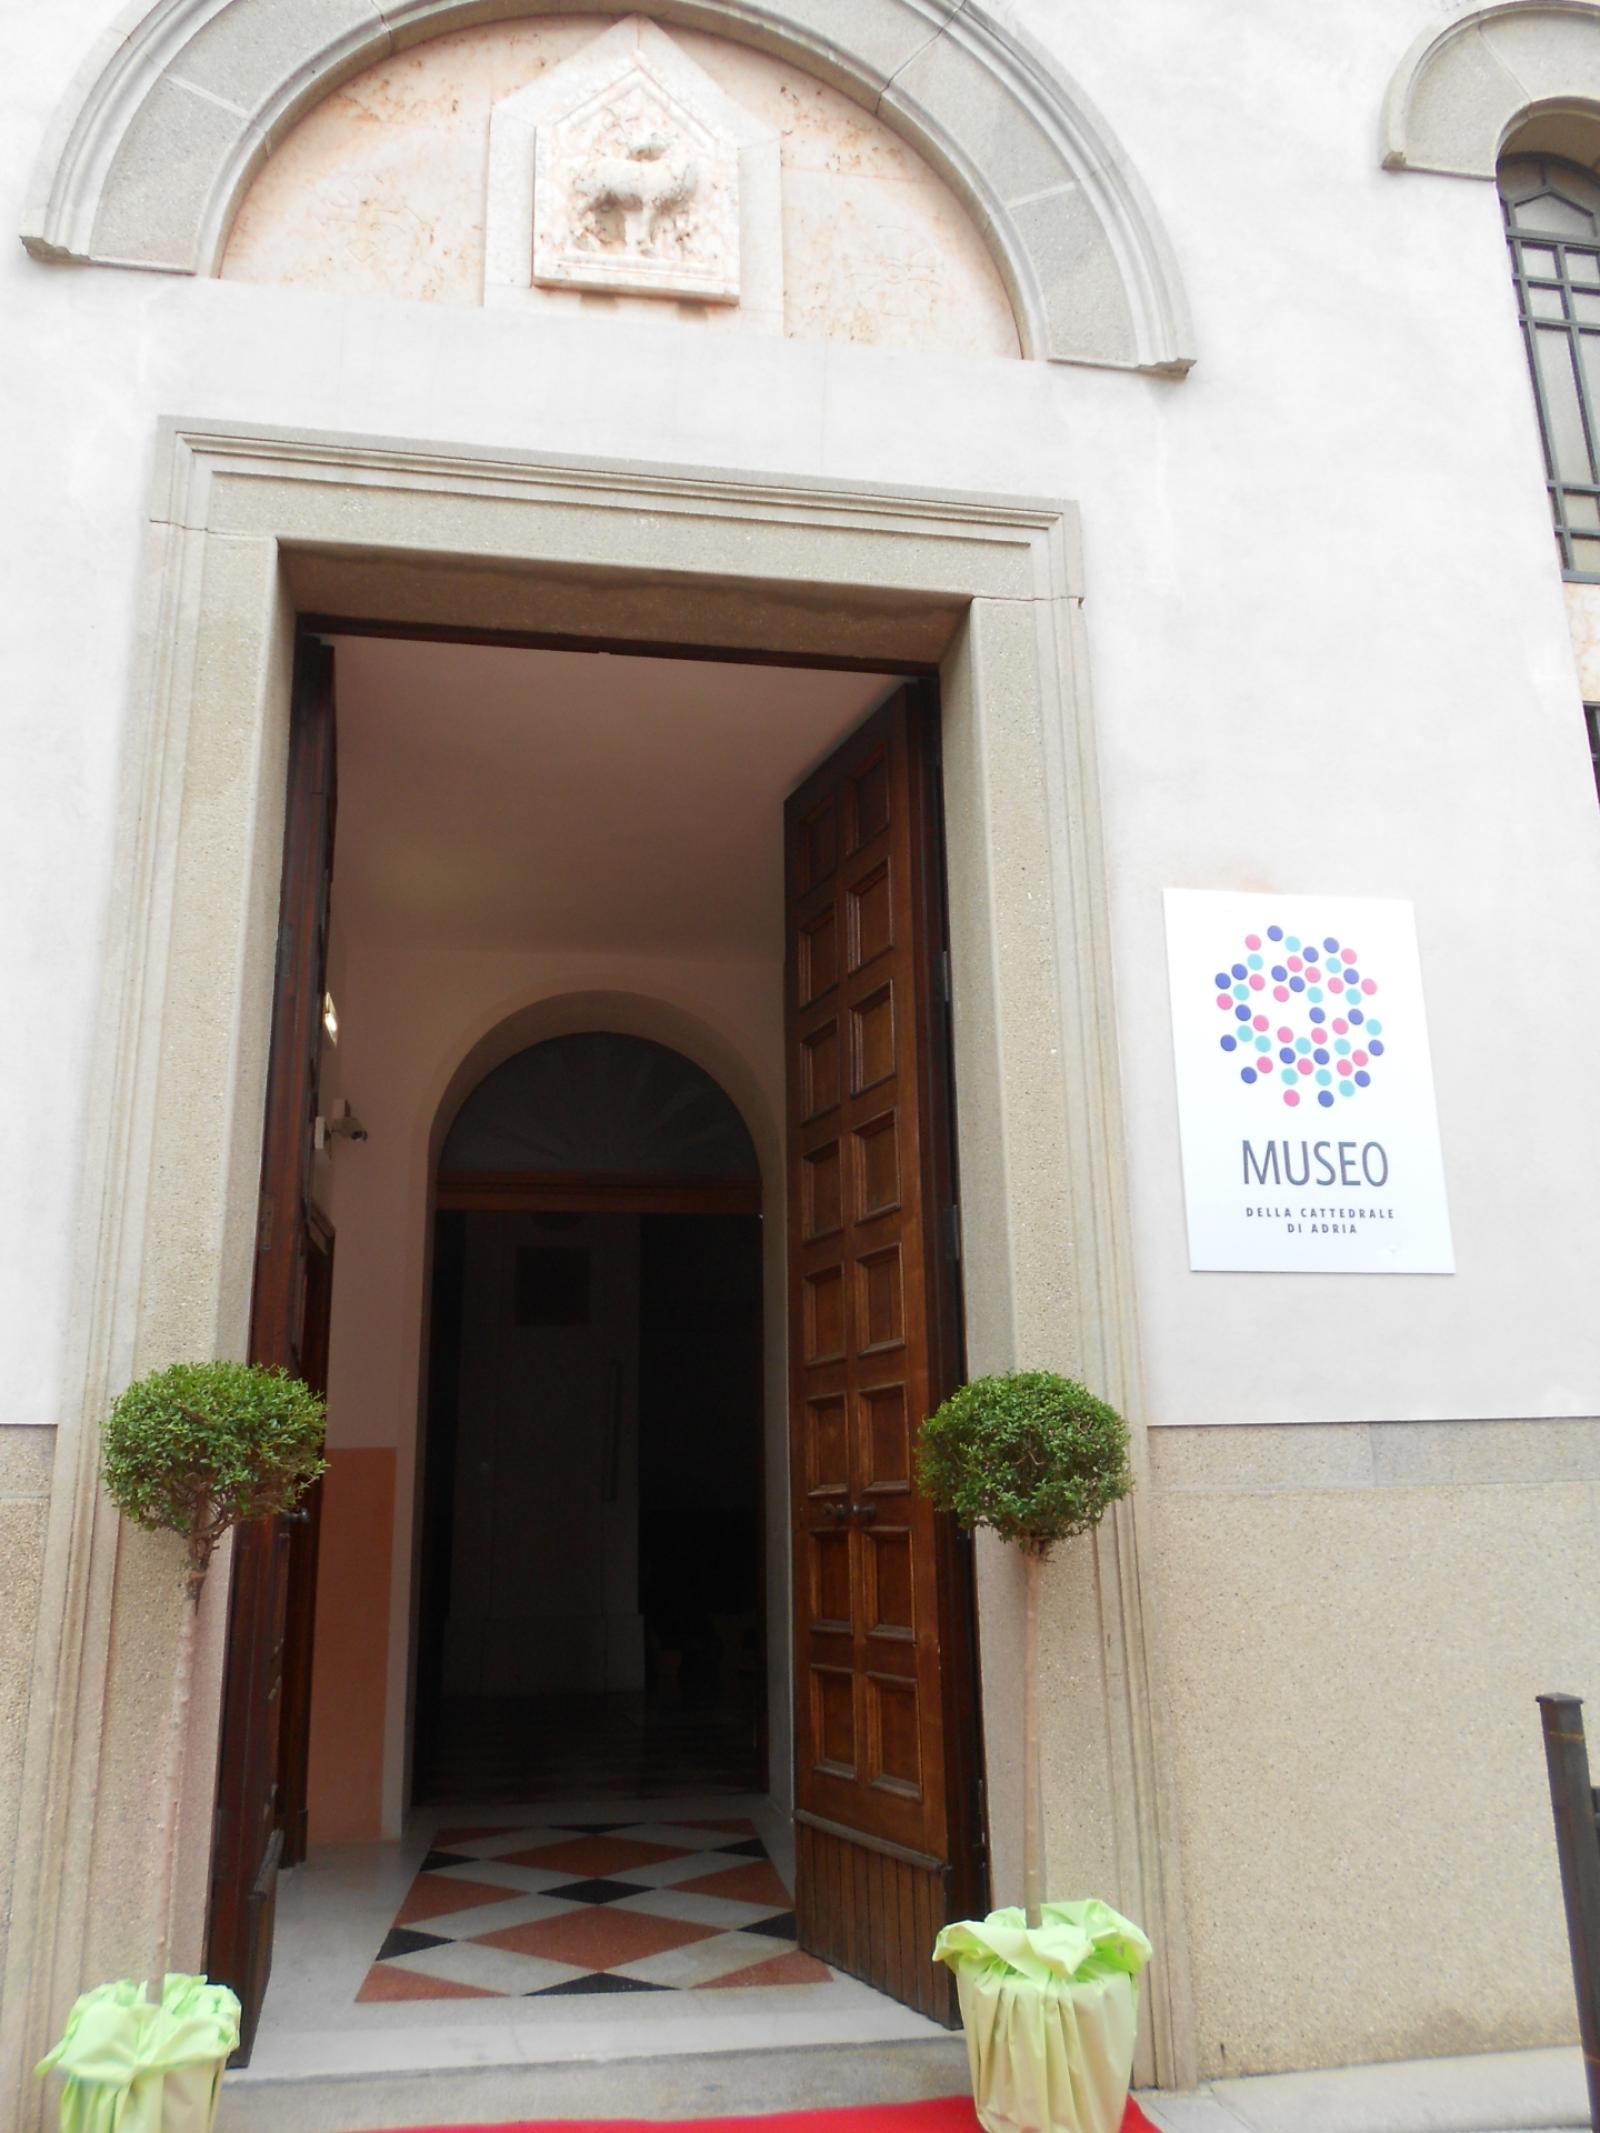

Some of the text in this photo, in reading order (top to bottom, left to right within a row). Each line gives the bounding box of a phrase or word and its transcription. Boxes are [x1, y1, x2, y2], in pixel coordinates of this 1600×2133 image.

[1242, 1139, 1389, 1187] MUSEO
[1246, 1207, 1394, 1219] DELLA CATTEDRALE
[1287, 1223, 1357, 1234] DI ADRIA
